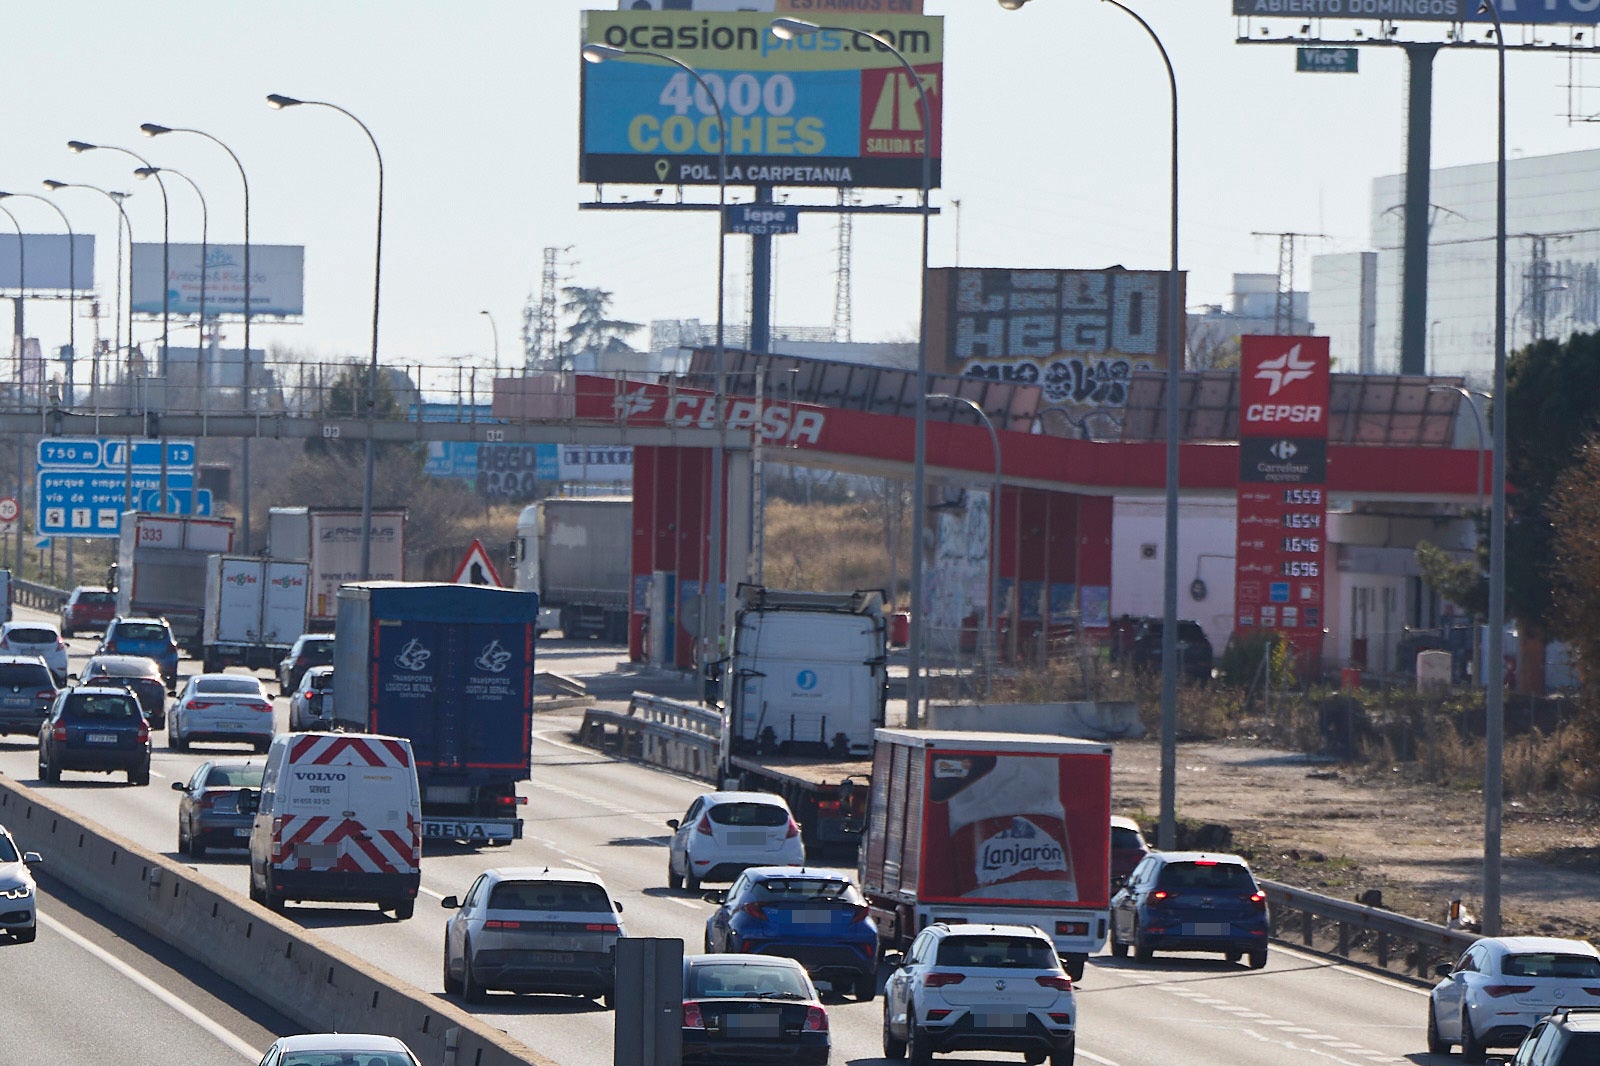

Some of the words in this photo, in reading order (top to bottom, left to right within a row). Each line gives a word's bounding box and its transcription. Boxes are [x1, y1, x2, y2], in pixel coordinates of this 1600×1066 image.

[1255, 0, 1338, 13] ABIERTO
[1349, 0, 1458, 15] DOMINGOS
[659, 72, 795, 116] 4000
[628, 115, 825, 154] COCHES
[866, 138, 911, 154] SALIDA
[680, 164, 717, 180] POL.
[724, 165, 743, 181] LA
[747, 165, 852, 182] CARPETANIA
[743, 208, 786, 224] iepe
[1246, 405, 1322, 423] CEPSA
[46, 448, 76, 459] 750
[83, 451, 93, 460] m
[173, 449, 189, 461] 13
[45, 478, 85, 489] parque
[70, 493, 85, 503] de
[1, 503, 14, 515] 70
[142, 528, 163, 542] 333
[294, 772, 346, 781] VOLVO
[309, 785, 331, 794] SERVICE
[982, 843, 1062, 870] Lanjarón
